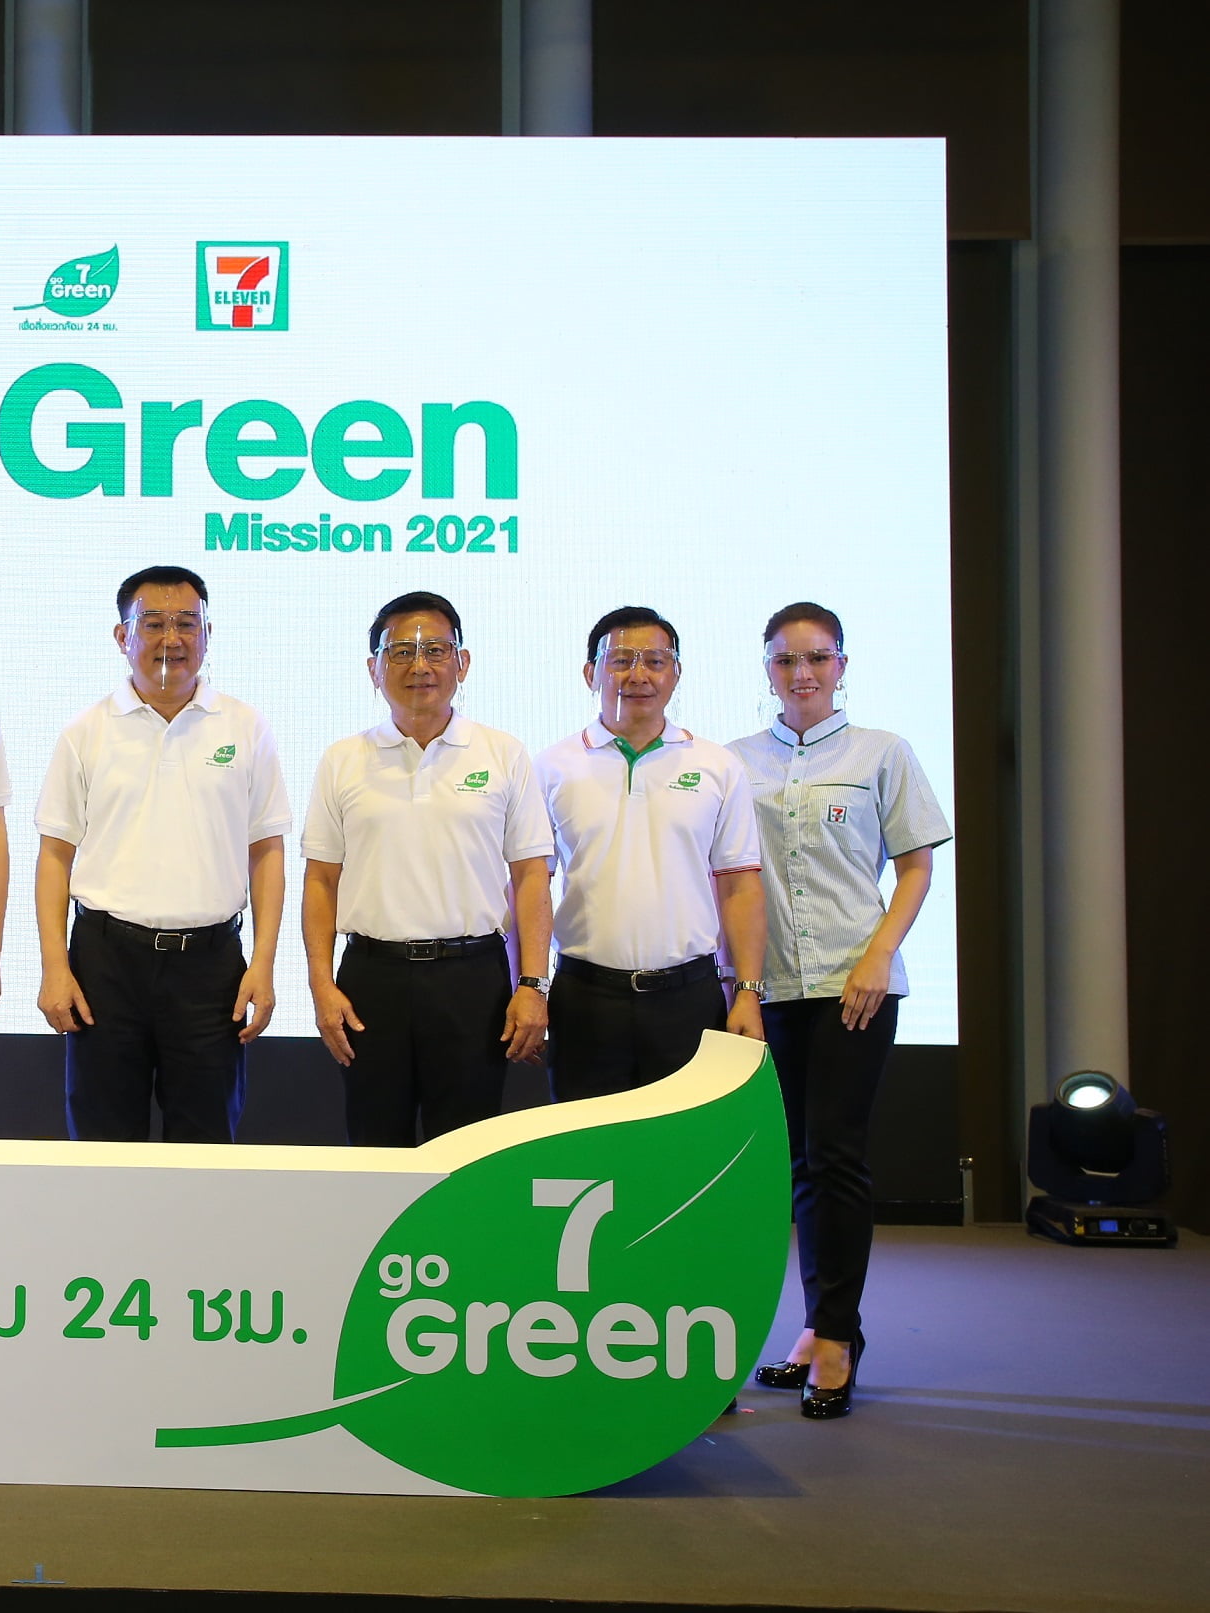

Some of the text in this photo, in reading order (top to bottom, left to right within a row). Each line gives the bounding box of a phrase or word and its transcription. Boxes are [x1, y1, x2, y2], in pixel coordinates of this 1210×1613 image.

[50, 277, 64, 285] go
[51, 284, 112, 299] Green
[75, 264, 91, 284] 7
[216, 256, 270, 328] 7
[87, 322, 100, 331] 24
[204, 512, 519, 554] Mission 2021
[832, 807, 844, 822] 7
[532, 1178, 614, 1293] 7
[378, 1253, 450, 1299] go
[62, 1276, 158, 1341] 24
[187, 1289, 308, 1345] ชม.
[386, 1298, 737, 1381] Green
